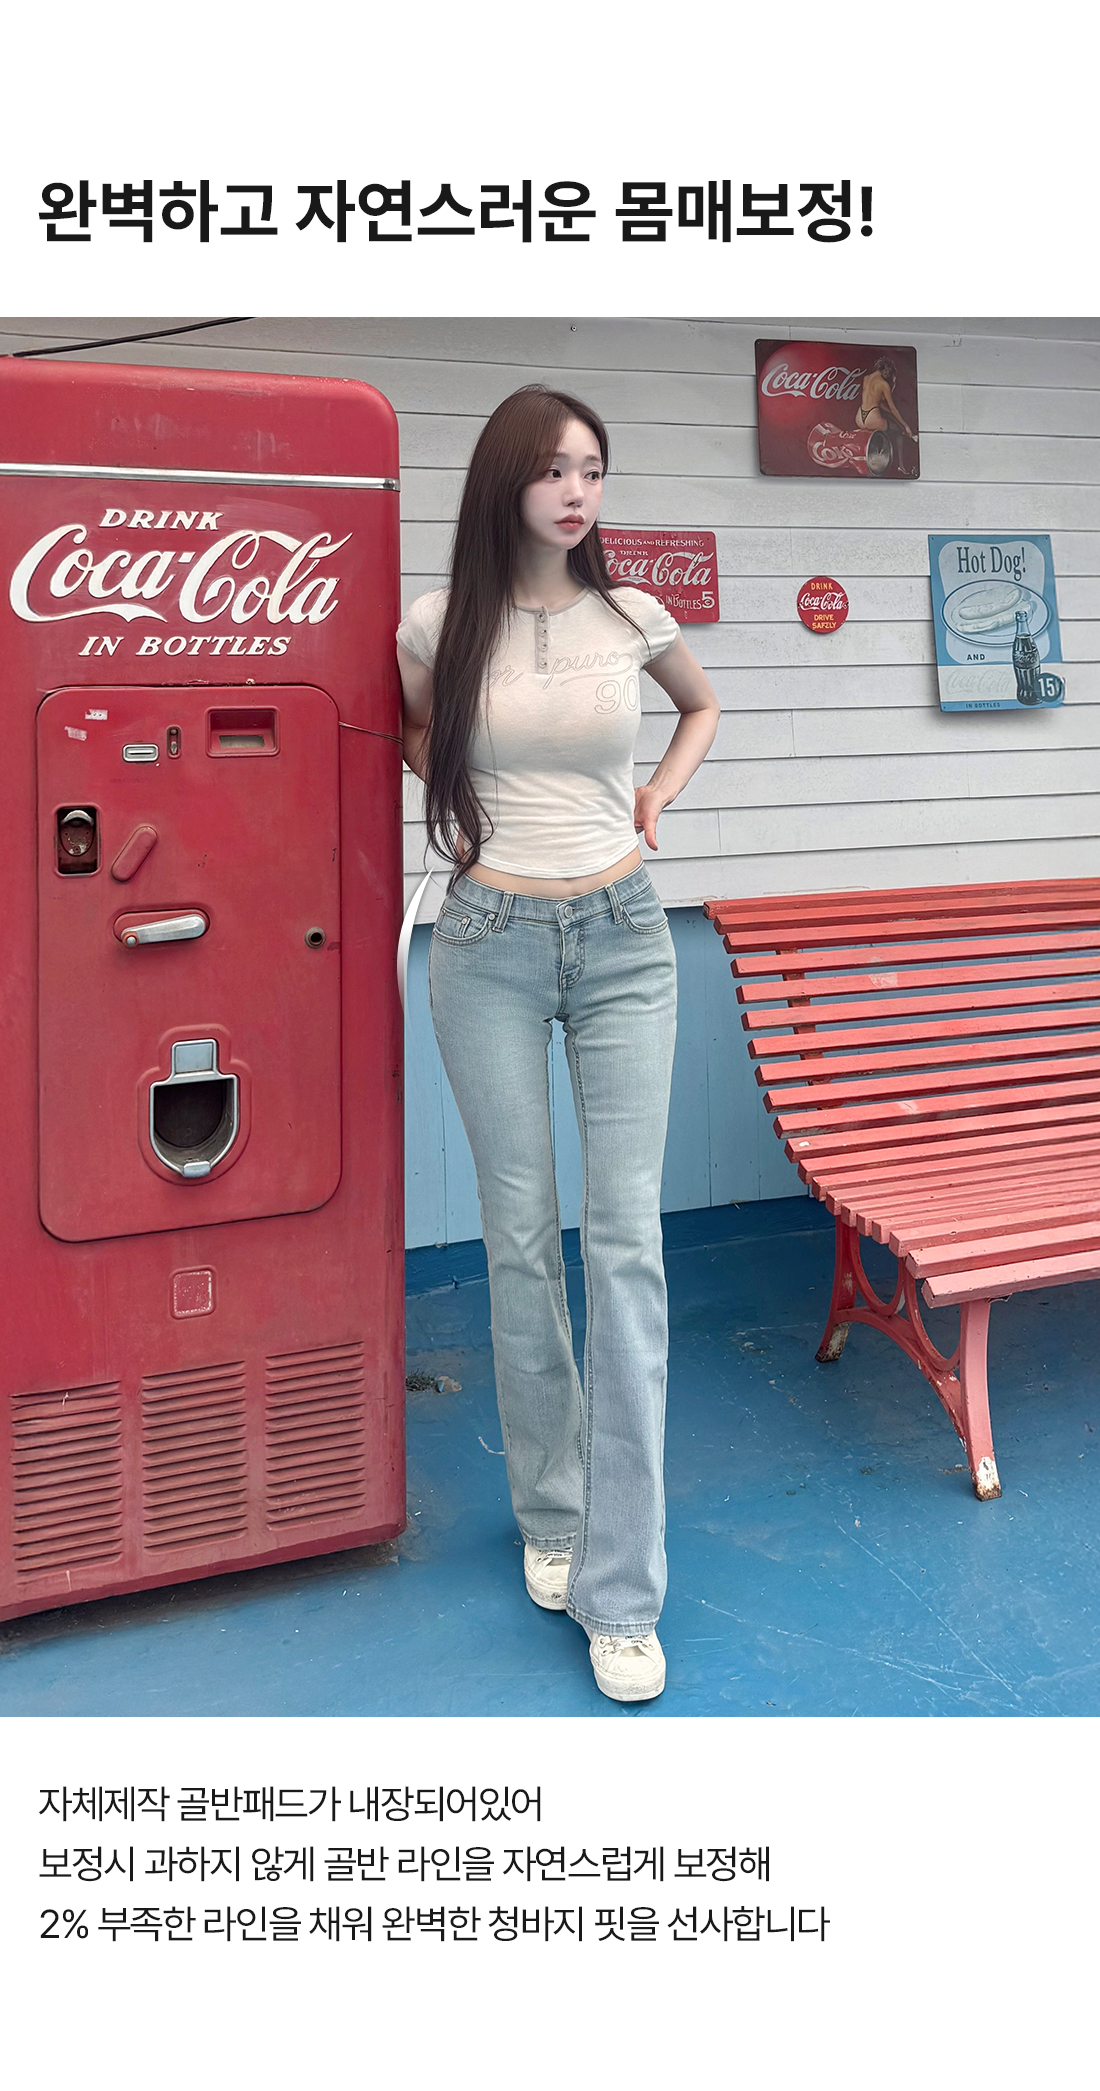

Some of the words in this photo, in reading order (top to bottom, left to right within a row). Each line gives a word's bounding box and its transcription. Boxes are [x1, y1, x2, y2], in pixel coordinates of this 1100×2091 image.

[761, 363, 867, 401] Coca-Cola
[99, 508, 223, 531] DRINK
[655, 539, 704, 547] REFRESHING
[9, 524, 353, 625] Coca-Cola
[956, 546, 987, 574] Hot
[990, 546, 1026, 581] Dog!
[810, 582, 833, 590] DRINK
[799, 592, 846, 611] Coca-Cola
[79, 636, 125, 656] IN
[136, 636, 291, 656] BOTTLES
[594, 675, 638, 714] 90
